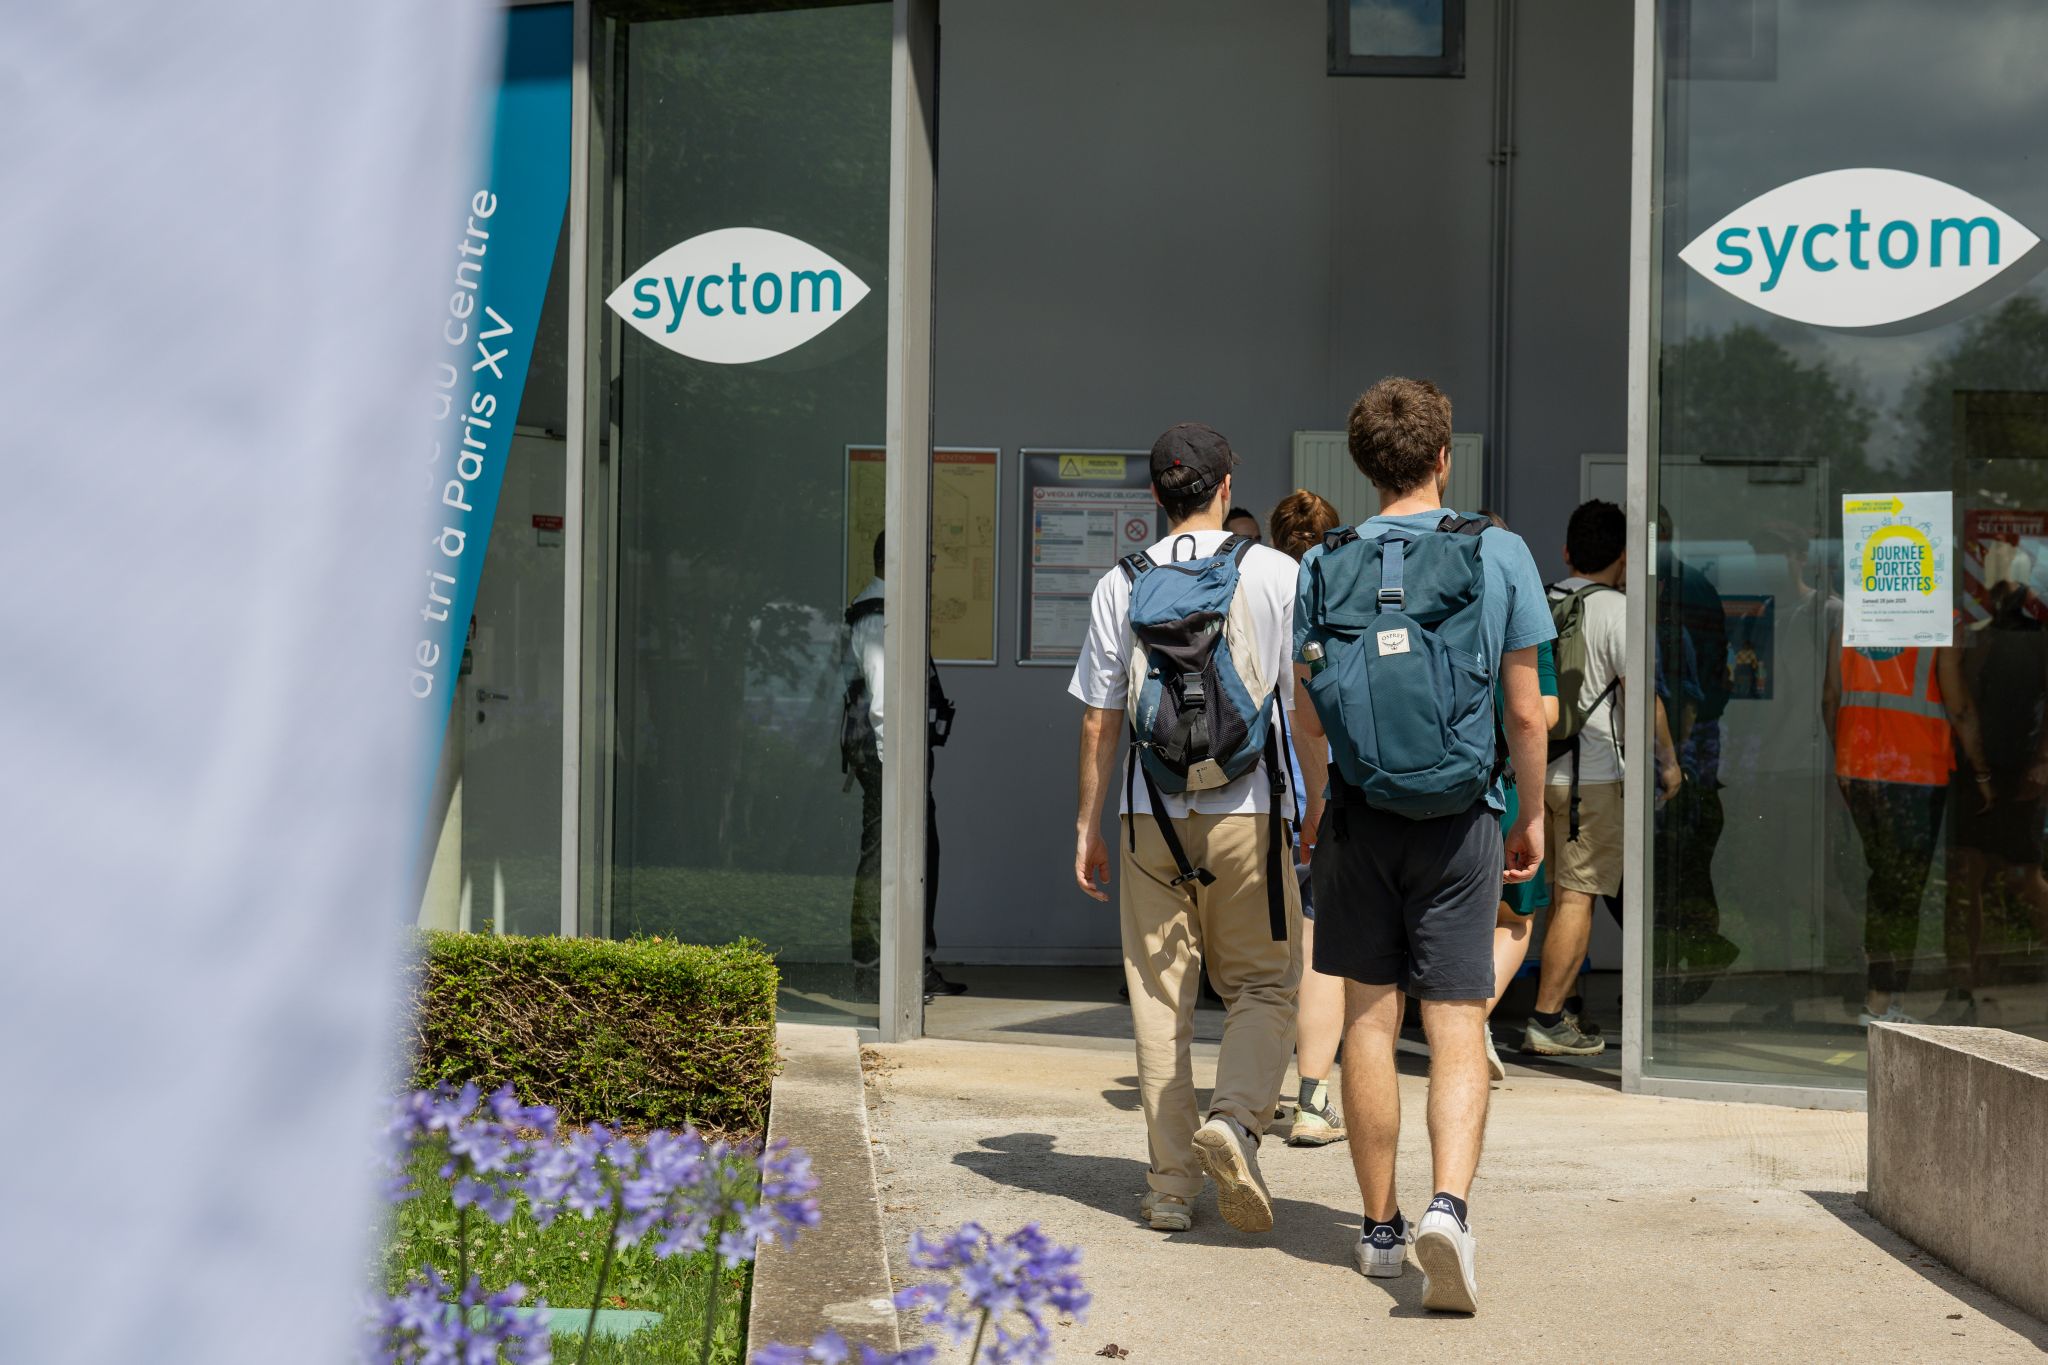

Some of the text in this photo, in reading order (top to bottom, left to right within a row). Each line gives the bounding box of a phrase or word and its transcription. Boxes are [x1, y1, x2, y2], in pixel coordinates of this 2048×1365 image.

[443, 190, 497, 346] centre
[1714, 208, 2000, 292] syctom
[632, 262, 842, 334] syctom
[472, 306, 514, 379] XV
[442, 391, 497, 512] Paris
[934, 453, 977, 462] VENTION
[432, 526, 467, 558] à
[1870, 541, 1925, 561] JOURNÉE
[1875, 561, 1921, 576] PORTES
[420, 569, 456, 622] tri
[1865, 575, 1931, 592] OUVERTES
[1381, 633, 1404, 641] OSPREY
[408, 639, 440, 699] de
